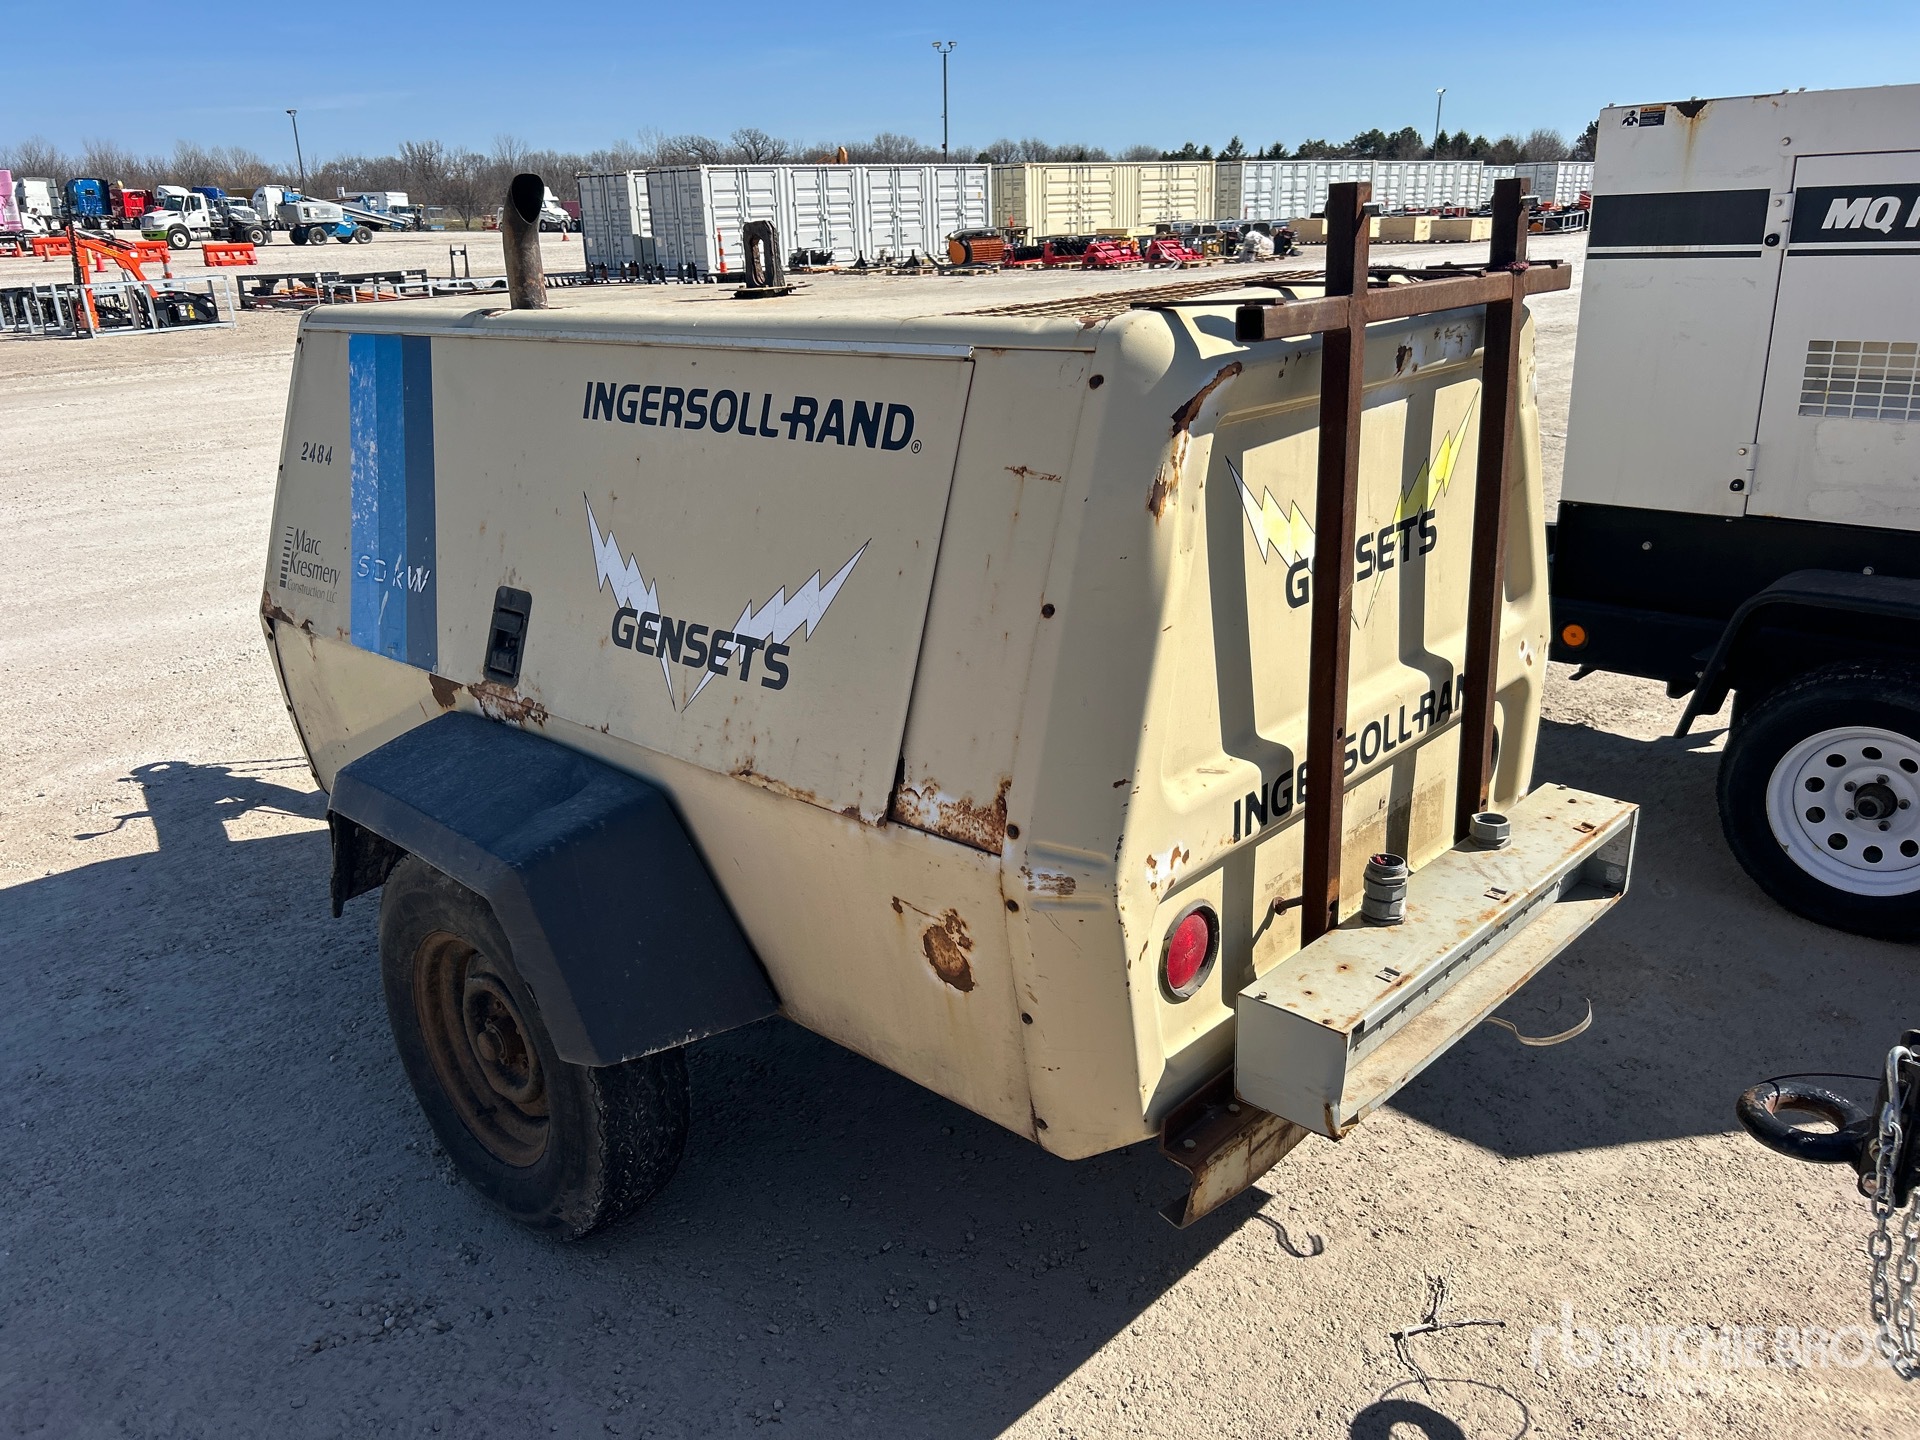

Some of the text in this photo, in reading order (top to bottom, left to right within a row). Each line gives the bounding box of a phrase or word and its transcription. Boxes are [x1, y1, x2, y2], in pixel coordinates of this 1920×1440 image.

[1821, 196, 1902, 234] MQ
[301, 441, 333, 466] 2484
[292, 528, 322, 556] Marc
[1285, 508, 1437, 609] GSETS
[289, 551, 341, 589] Kresmery
[287, 579, 338, 604] Construction LLC
[612, 606, 790, 691] GENSETS
